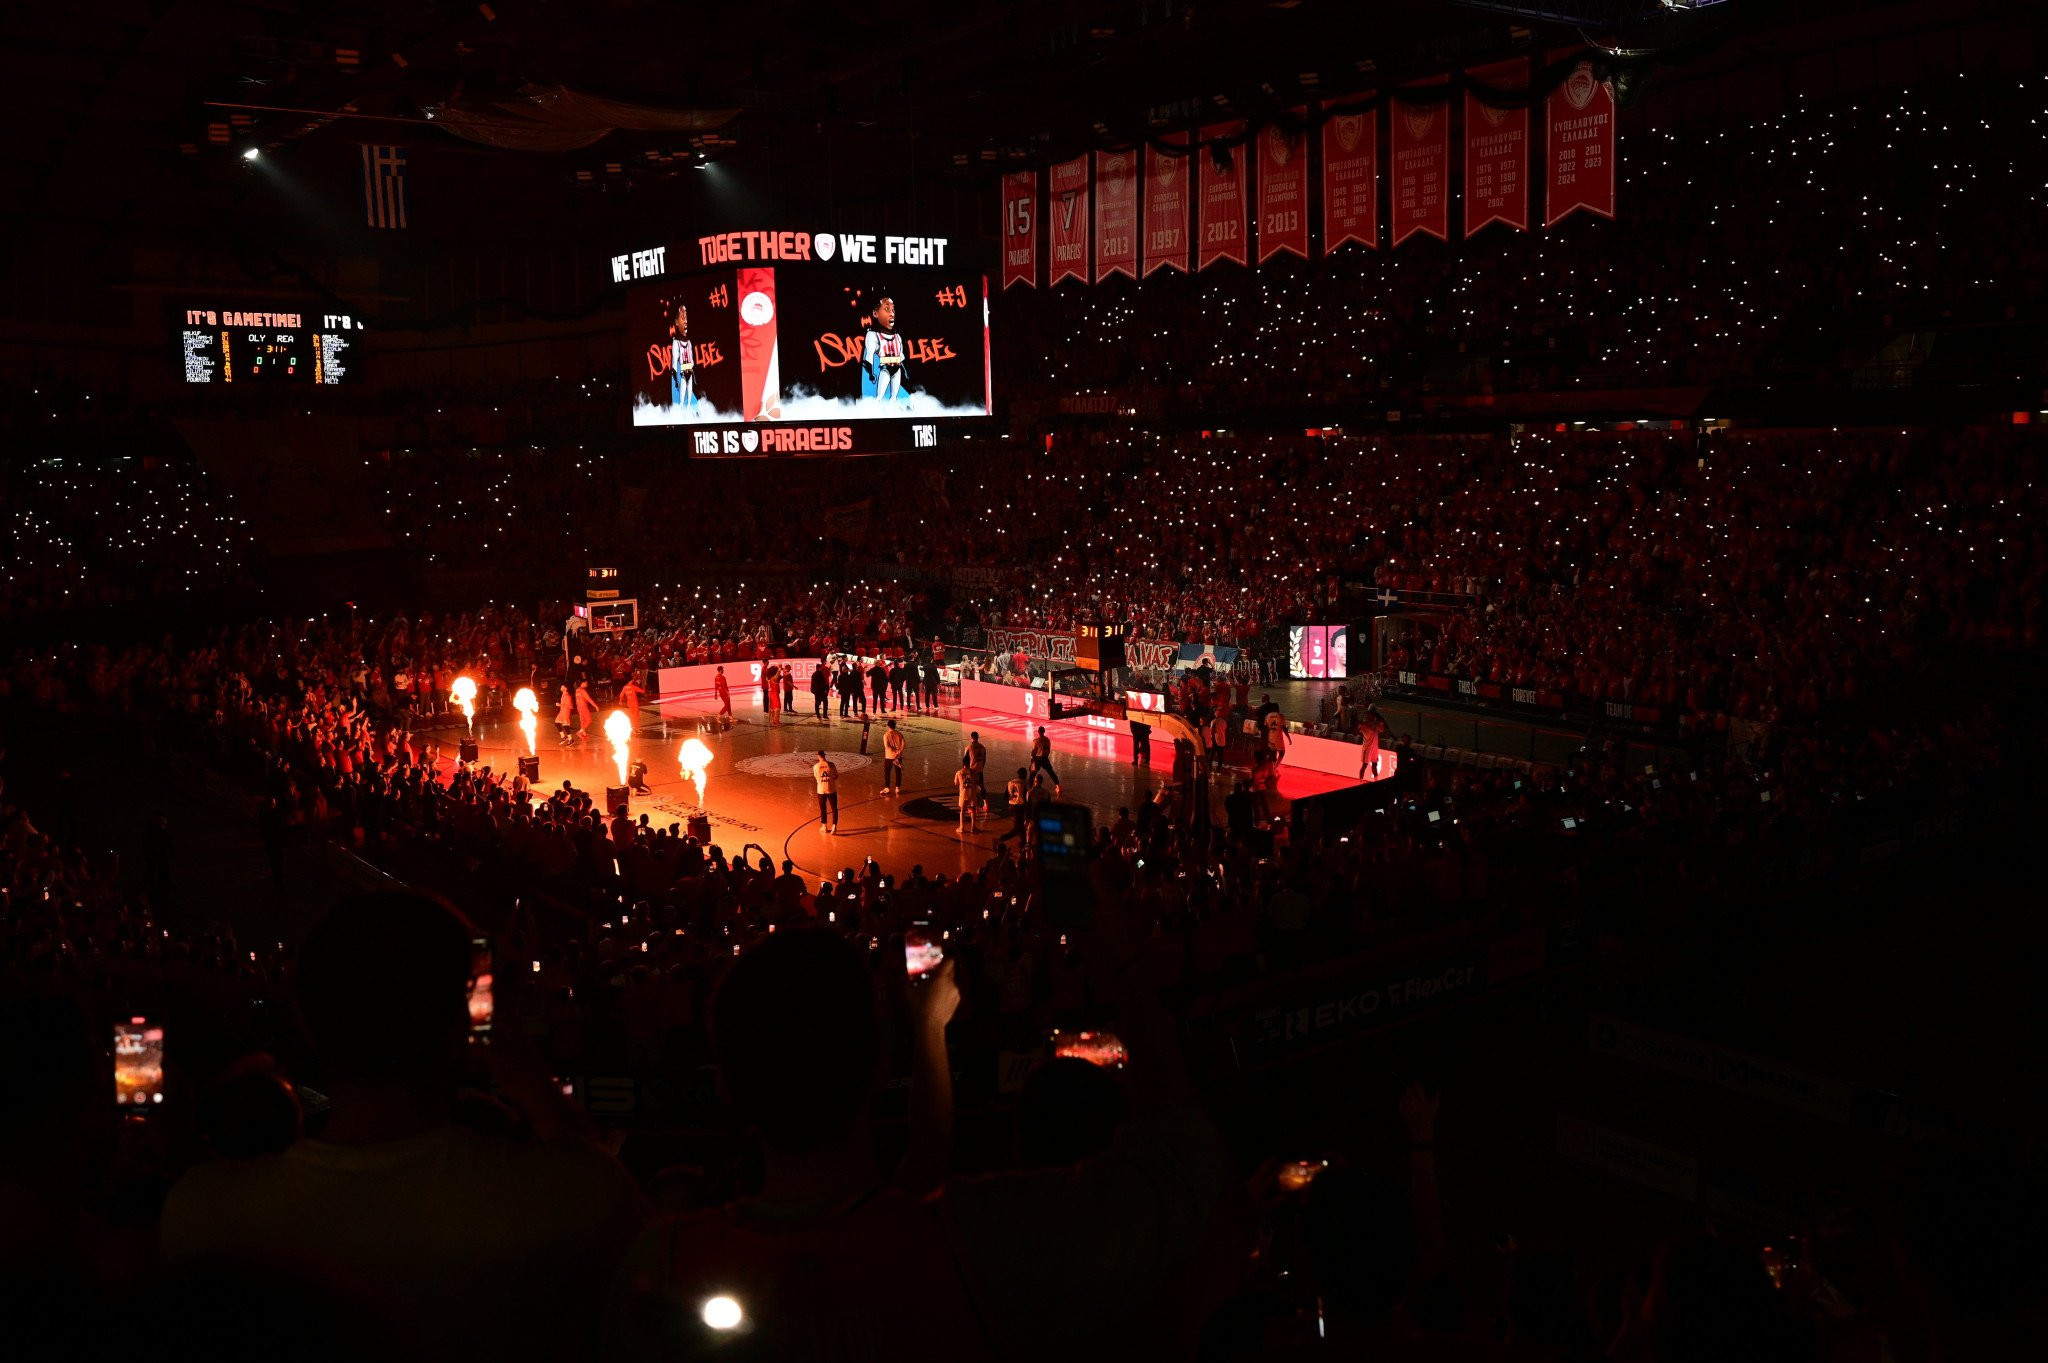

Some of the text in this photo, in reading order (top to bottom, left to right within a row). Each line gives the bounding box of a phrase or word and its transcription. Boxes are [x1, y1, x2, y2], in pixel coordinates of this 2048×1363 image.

[1562, 127, 1598, 143] ΕΛΛΑΔΑΣ
[1480, 143, 1513, 158] ΕΛΛΑΔΑΣ
[1585, 144, 1601, 156] 2011
[1476, 159, 1516, 175] 1976 1977
[1558, 156, 1602, 173] 2022 2023
[1208, 182, 1236, 194] EUROPEAN
[1268, 181, 1296, 193] EUROPEAN
[1476, 171, 1516, 187] 1978 1980
[1557, 173, 1576, 185] 2024
[1208, 190, 1237, 203] CHAMPIONS
[1267, 190, 1298, 204] CHAMPIONS
[1476, 183, 1516, 199] 1994 1997
[1008, 197, 1031, 236] 15
[1062, 191, 1077, 229] 7
[1267, 210, 1298, 234] 2013
[1151, 228, 1180, 250] 1997
[1207, 220, 1237, 243] 2012
[698, 231, 948, 266] TOGETHER WE FIGHT
[1057, 243, 1081, 262] PIRAEUS
[1103, 236, 1129, 257] 2013
[611, 246, 666, 283] WE FIGHT
[1008, 248, 1030, 266] PIRAEUS
[709, 282, 729, 308] #9
[936, 284, 967, 309] #9
[186, 310, 302, 328] IT'S GAMETIME!
[323, 315, 352, 330] IT'S
[248, 334, 294, 343] OLY REA
[695, 341, 725, 368] LEE
[908, 337, 958, 364] LEE
[256, 356, 262, 365] 0
[290, 357, 296, 366] 0
[693, 427, 853, 454] THIS IS PIRAEUS
[912, 425, 933, 447] THIS
[1104, 624, 1124, 638] 311
[987, 629, 1050, 659] ΛΕΥΤΕΡΙΑ
[1139, 641, 1171, 671] ΜΑΣ
[750, 663, 762, 682] 9
[1398, 670, 1417, 686] WE ARE
[1458, 679, 1470, 694] THIS
[1025, 692, 1034, 714] 9
[1605, 701, 1623, 718] TEAM
[1315, 989, 1381, 1029] EKO
[1403, 966, 1475, 1003] FlexCar
[1751, 1065, 1821, 1099] MARINE
